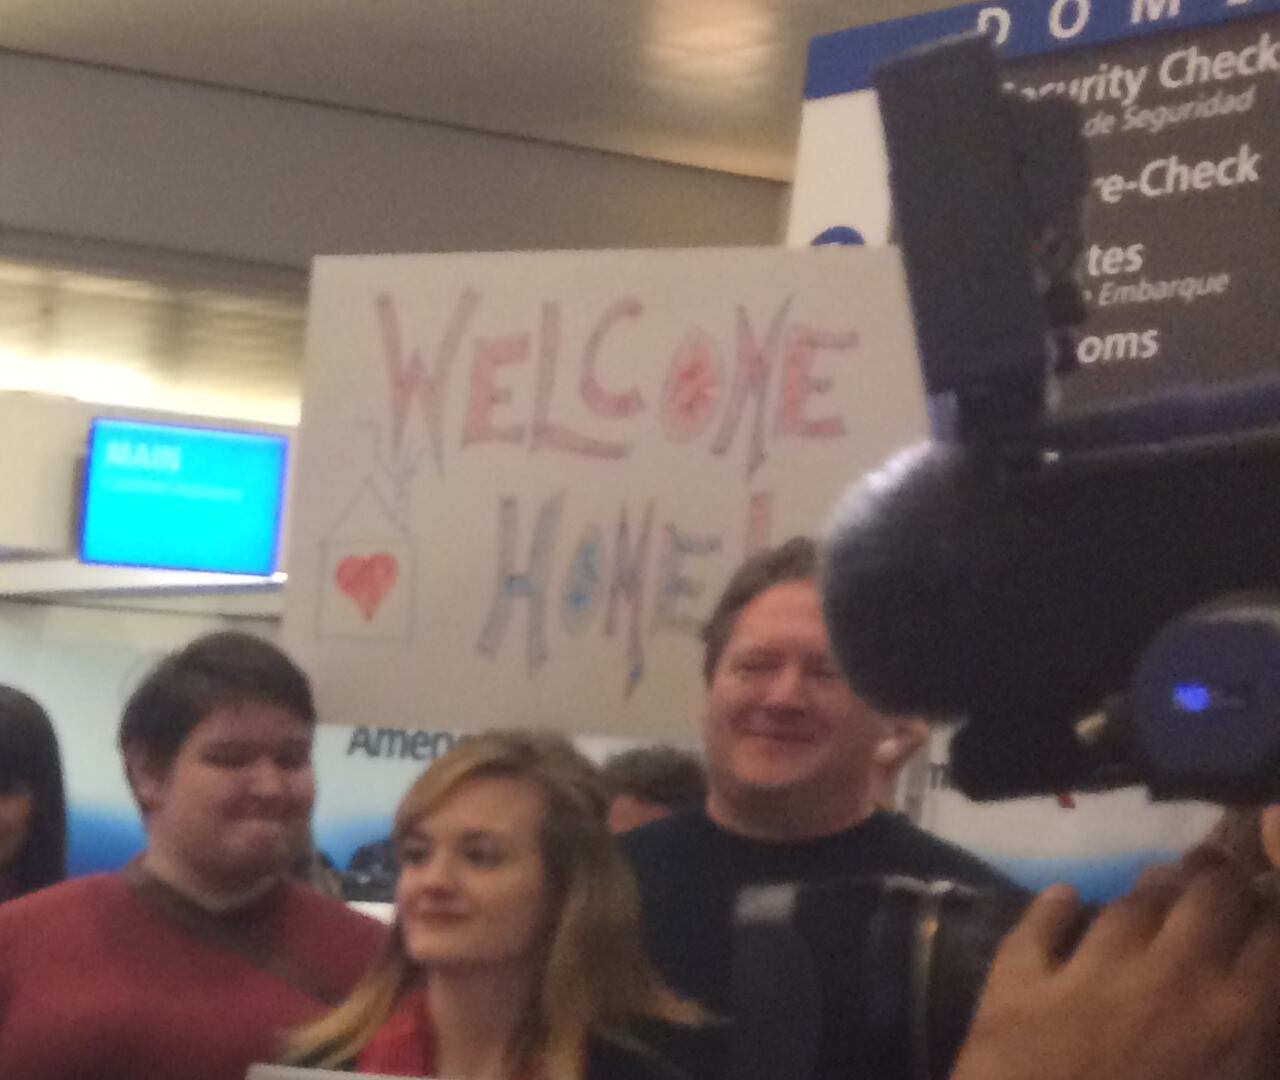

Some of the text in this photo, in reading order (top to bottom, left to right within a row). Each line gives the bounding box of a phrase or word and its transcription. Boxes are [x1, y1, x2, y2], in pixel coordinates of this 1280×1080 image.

[1122, 86, 1256, 133] Seguridad
[1088, 243, 1144, 276] tes
[1098, 273, 1230, 306] Embarque
[375, 287, 861, 480] WELCOME
